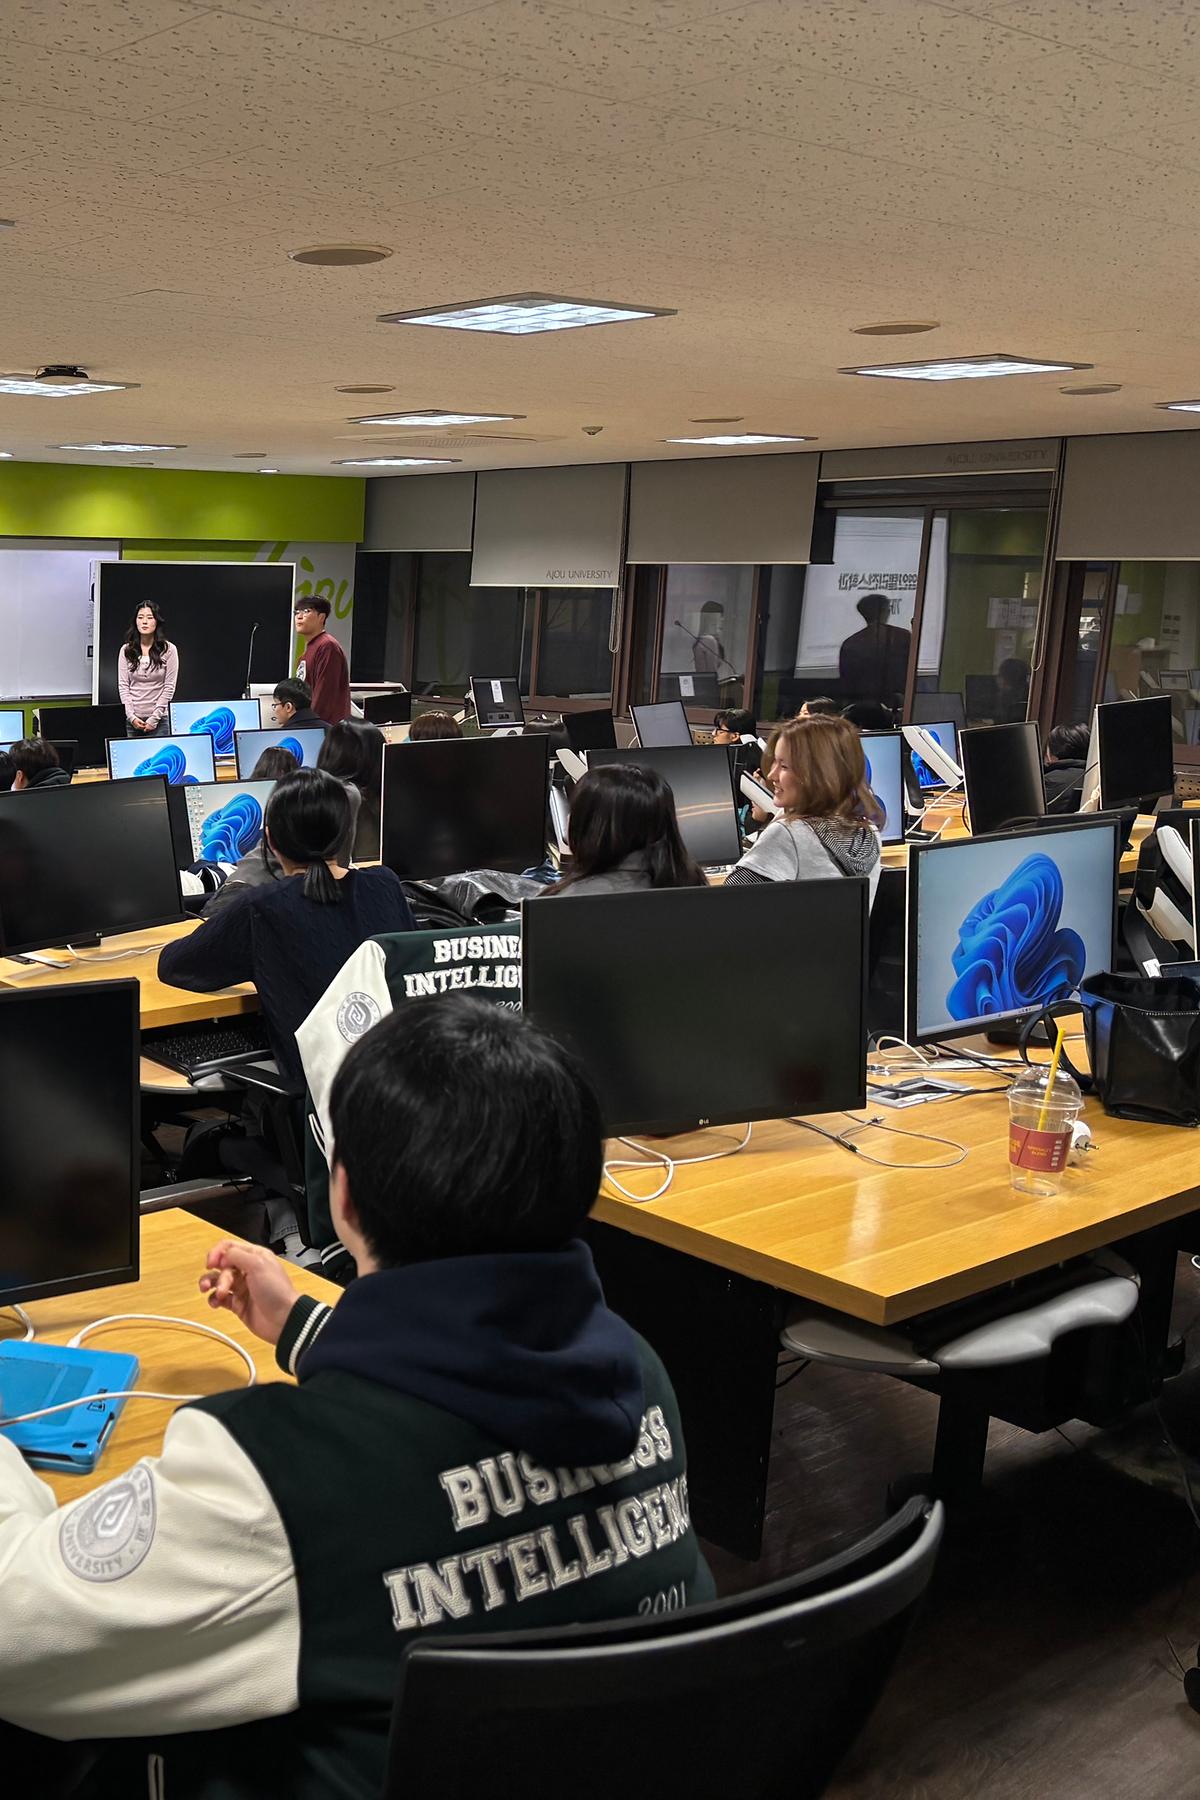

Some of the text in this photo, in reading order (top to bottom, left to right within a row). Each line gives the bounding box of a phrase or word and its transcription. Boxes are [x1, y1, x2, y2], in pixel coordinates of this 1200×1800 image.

[545, 569, 613, 579] AJOU UNIVERSITY
[403, 964, 521, 998] INTELLIG
[438, 1405, 674, 1533] BUSSS
[64, 1521, 123, 1574] UNIVERSITY
